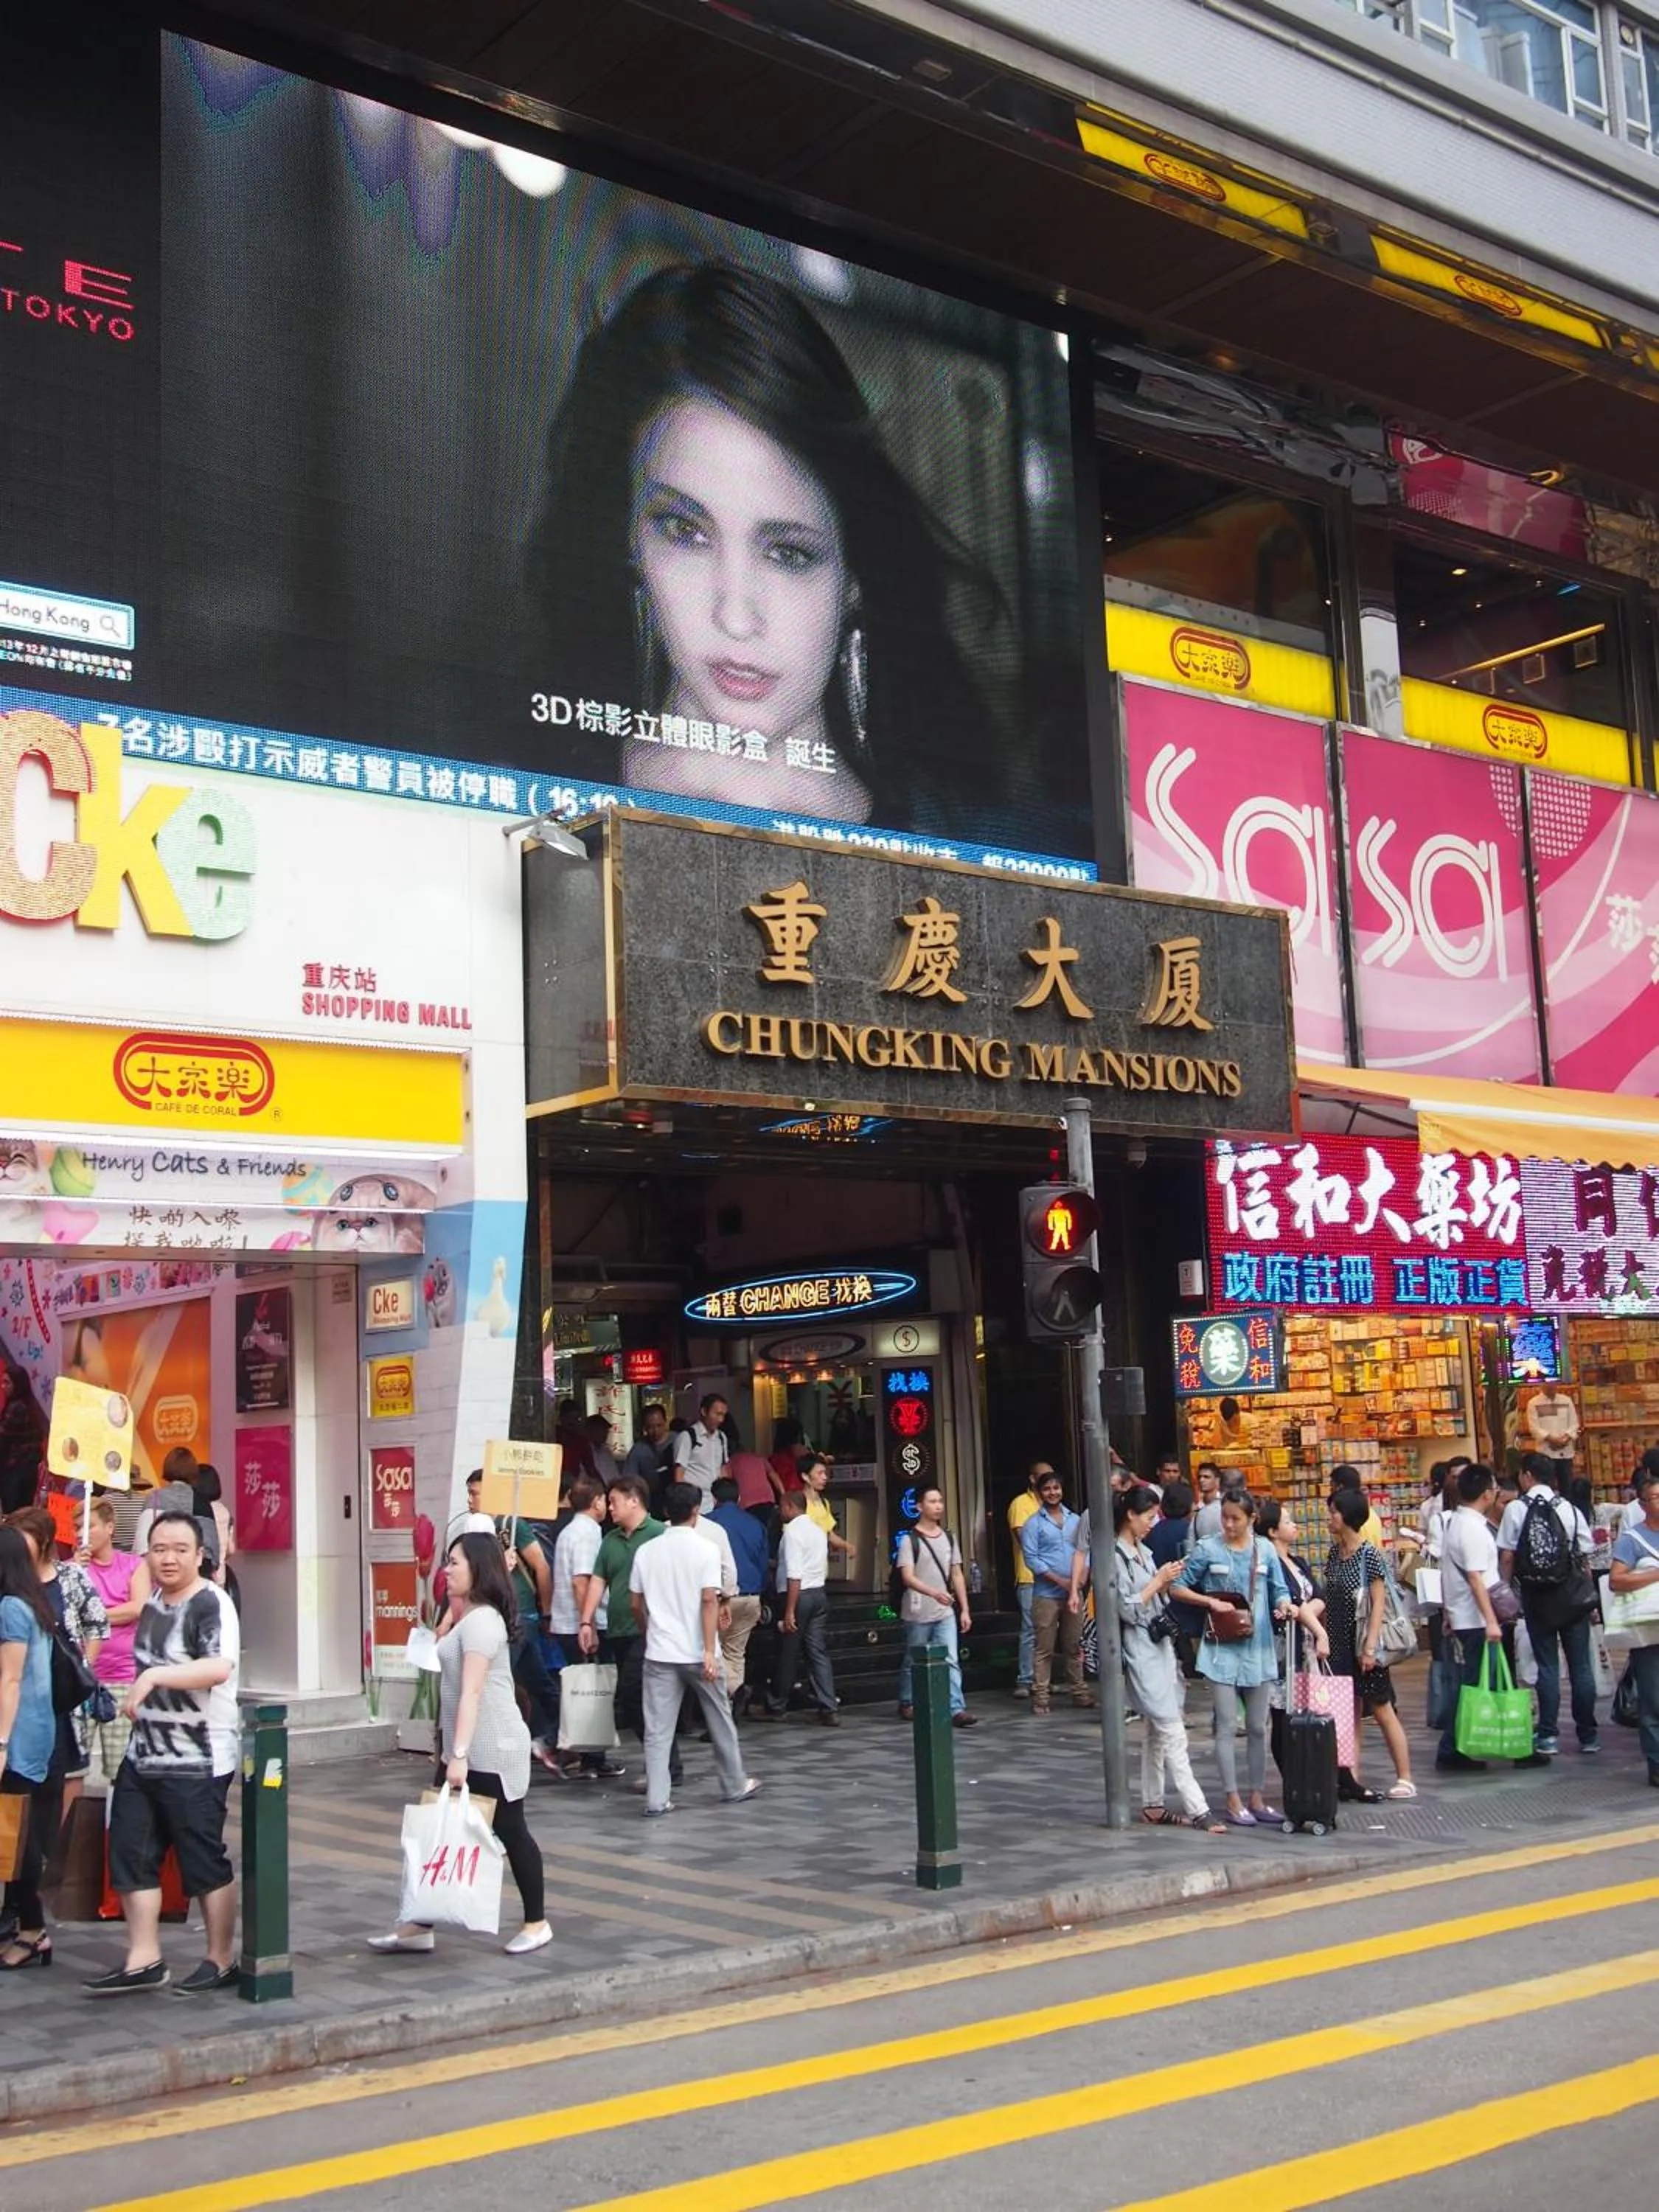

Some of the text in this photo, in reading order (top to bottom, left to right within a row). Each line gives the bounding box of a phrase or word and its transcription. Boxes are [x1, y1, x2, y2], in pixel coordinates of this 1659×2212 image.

[0, 287, 134, 341] TOKYO
[46, 606, 90, 633] Kong
[784, 737, 836, 773] 誕生
[302, 961, 377, 993] 重庆站
[302, 992, 473, 1030] SHOPPING MALL
[706, 1011, 1242, 1097] CHUNGKING MANSIONS
[136, 1055, 252, 1104] 大家樂
[186, 1103, 200, 1114] DE
[203, 1105, 237, 1117] CORAL
[82, 1150, 307, 1182] Henry Cats & Friends
[740, 1279, 830, 1315] CHANGE
[1223, 1252, 1529, 1307] 政府註冊 正版正貨
[373, 1288, 399, 1315] Cke
[1208, 1326, 1242, 1377] 藥
[376, 1602, 419, 1622] mannings
[420, 1845, 480, 1888] H&M
